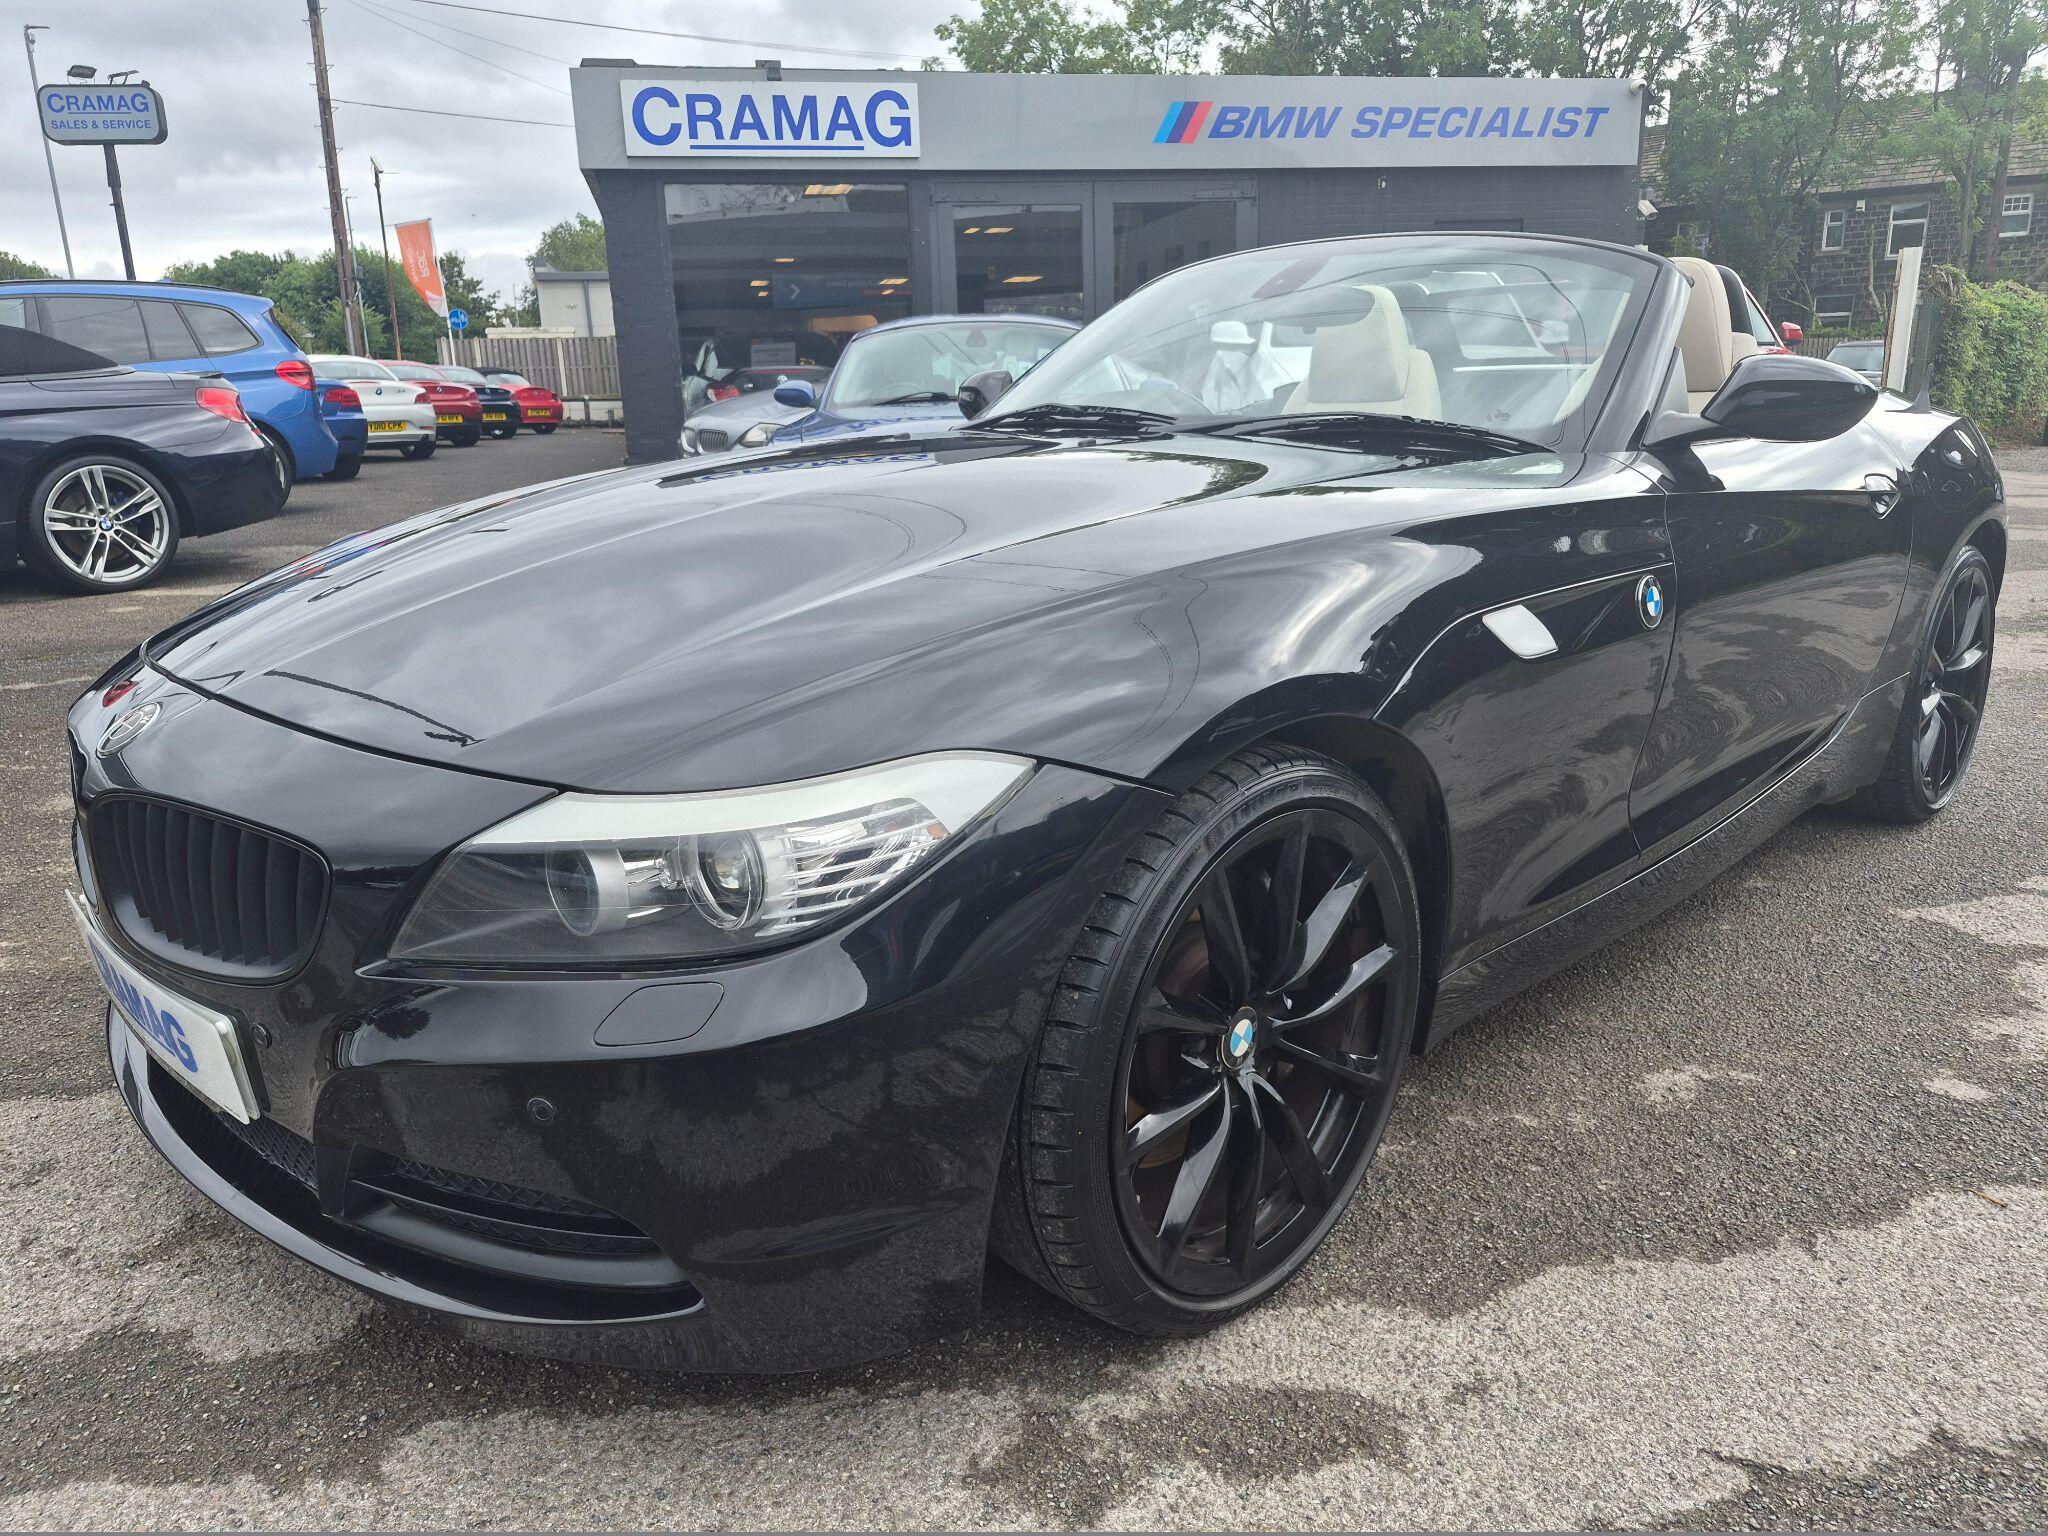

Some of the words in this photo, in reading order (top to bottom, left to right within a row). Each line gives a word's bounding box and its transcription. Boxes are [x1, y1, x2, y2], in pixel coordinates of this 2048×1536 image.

[46, 93, 150, 113] CRAMAG
[51, 119, 89, 130] SALES
[91, 119, 99, 130] &
[102, 118, 152, 130] SERVICE
[632, 86, 912, 147] CRAMAG
[1207, 106, 1344, 139] BMW
[1350, 106, 1610, 139] SPECIALIST
